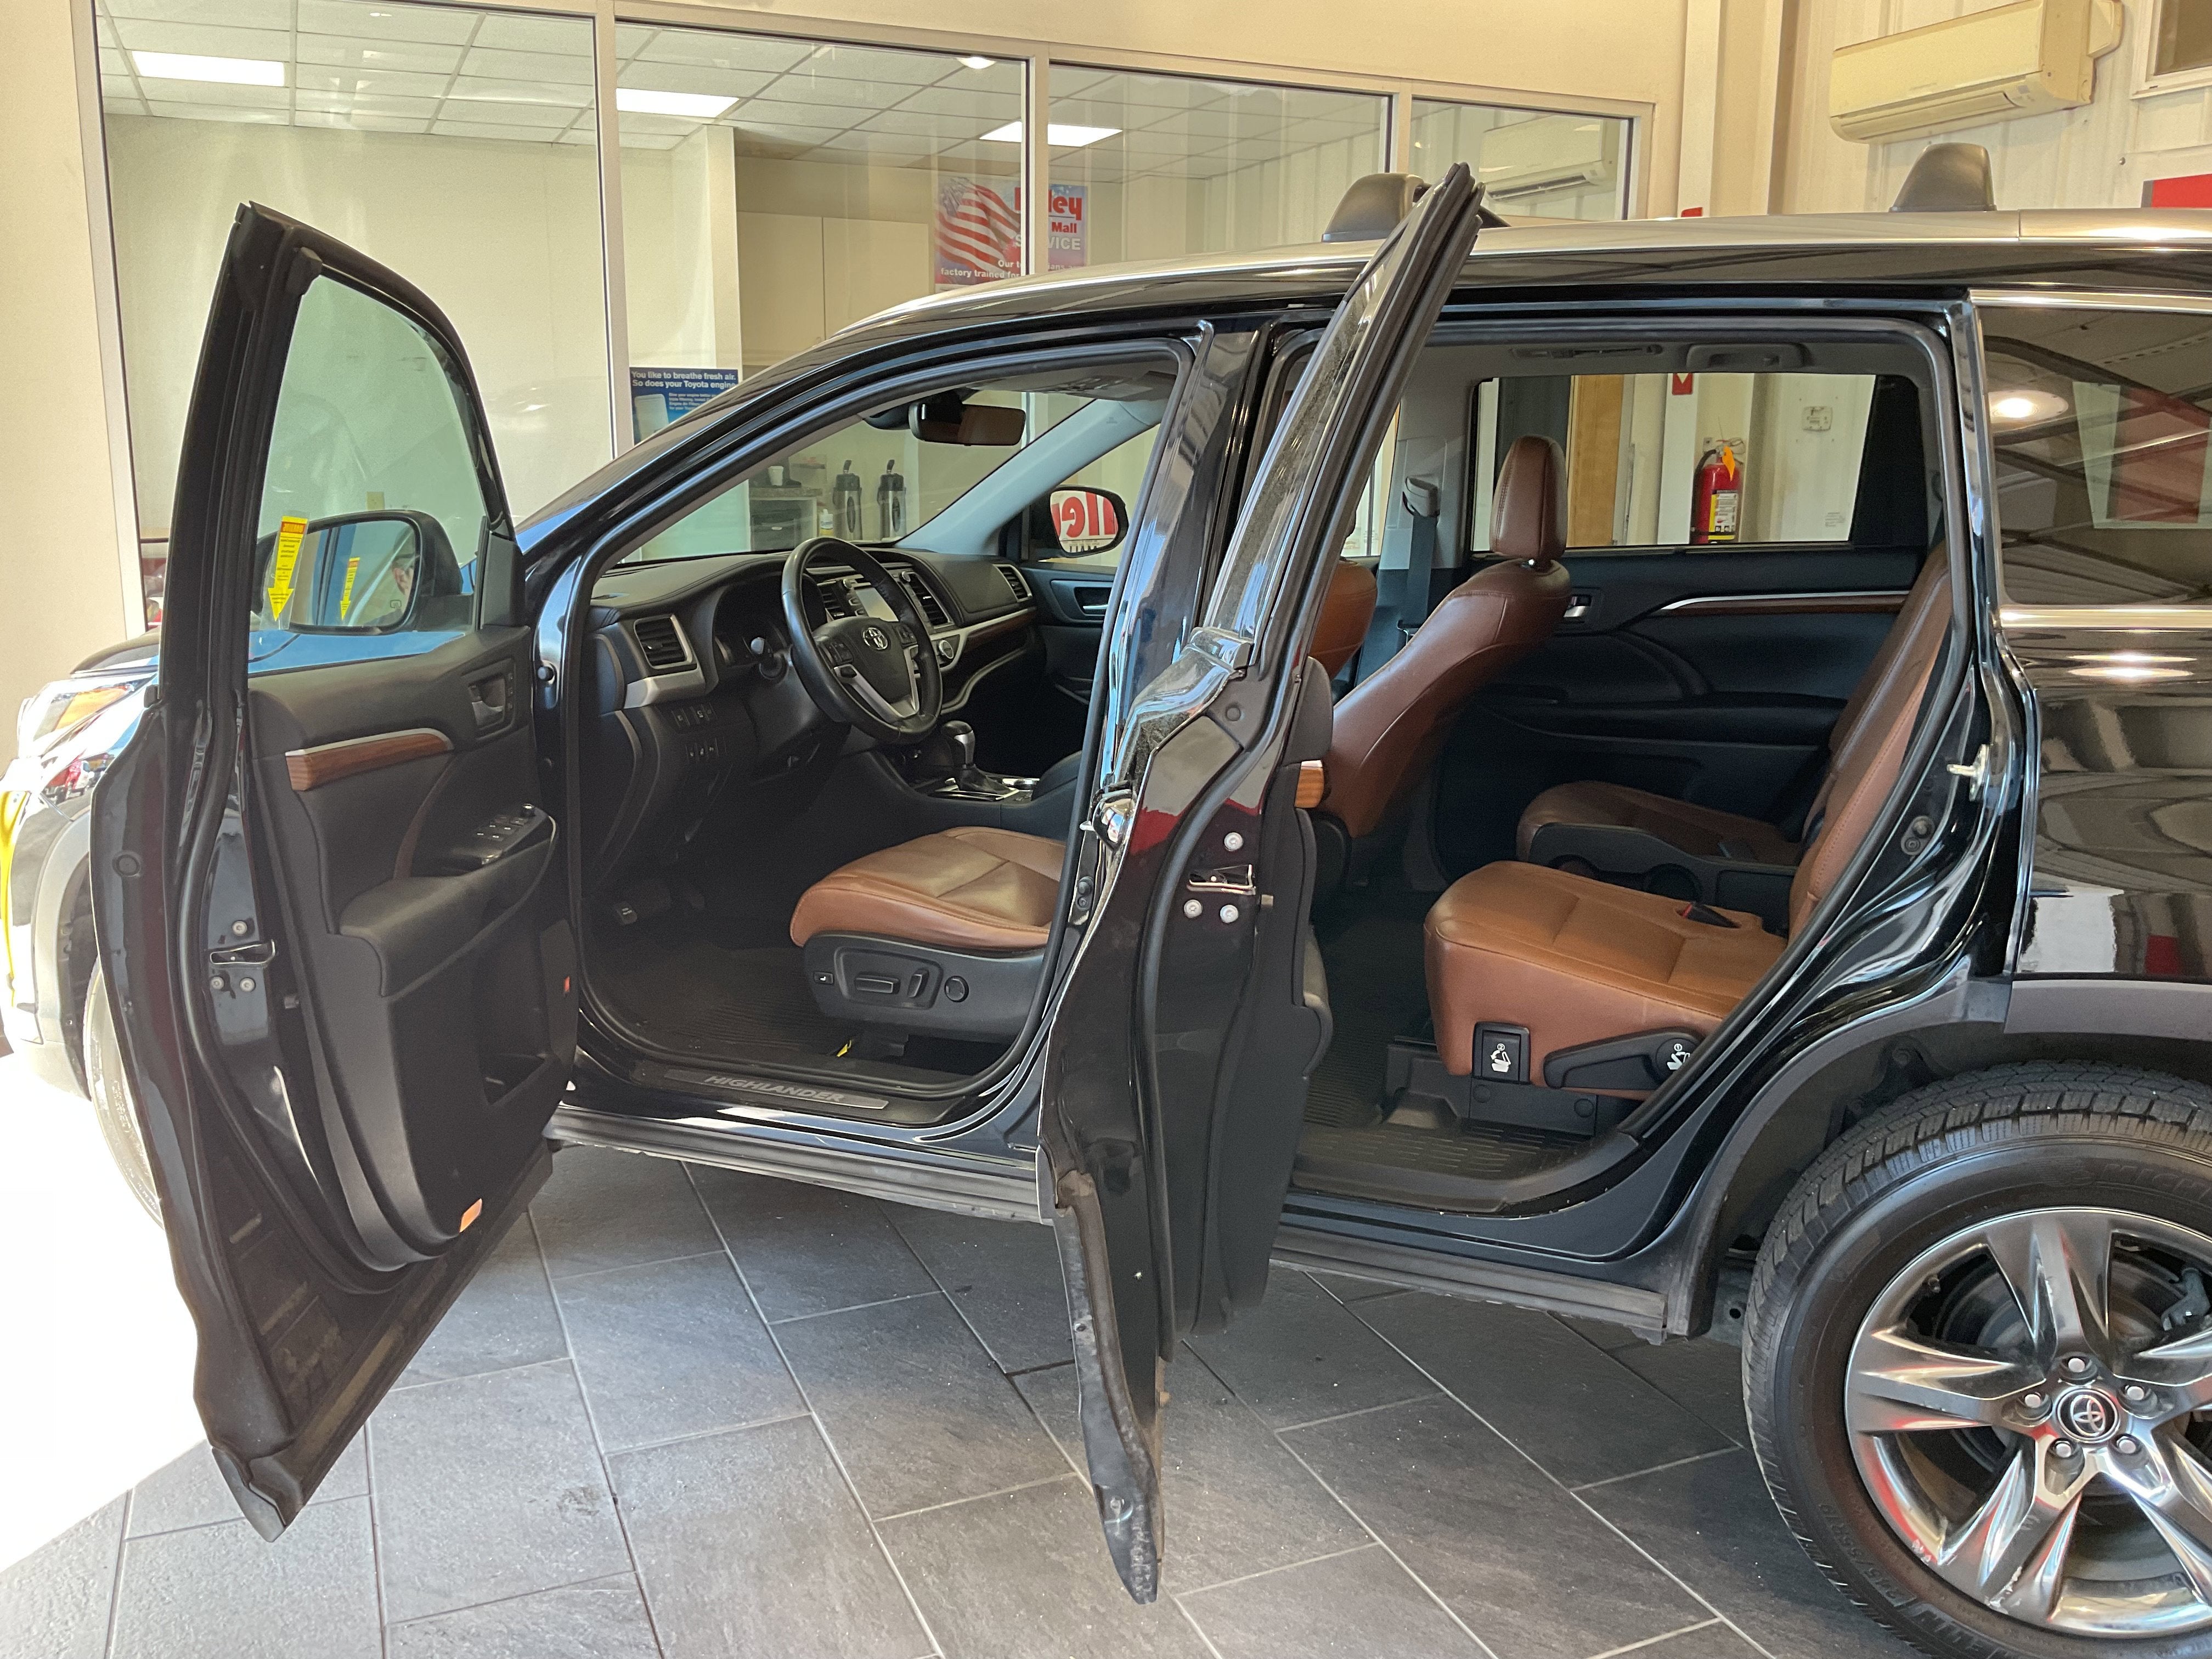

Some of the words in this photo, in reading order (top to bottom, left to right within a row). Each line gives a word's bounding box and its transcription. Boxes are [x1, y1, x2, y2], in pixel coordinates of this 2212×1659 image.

[1051, 222, 1077, 233] Mall
[940, 268, 972, 278] factory
[974, 269, 1005, 278] trained
[684, 380, 709, 388] Toyota
[704, 1076, 844, 1102] HIGHLANDER
